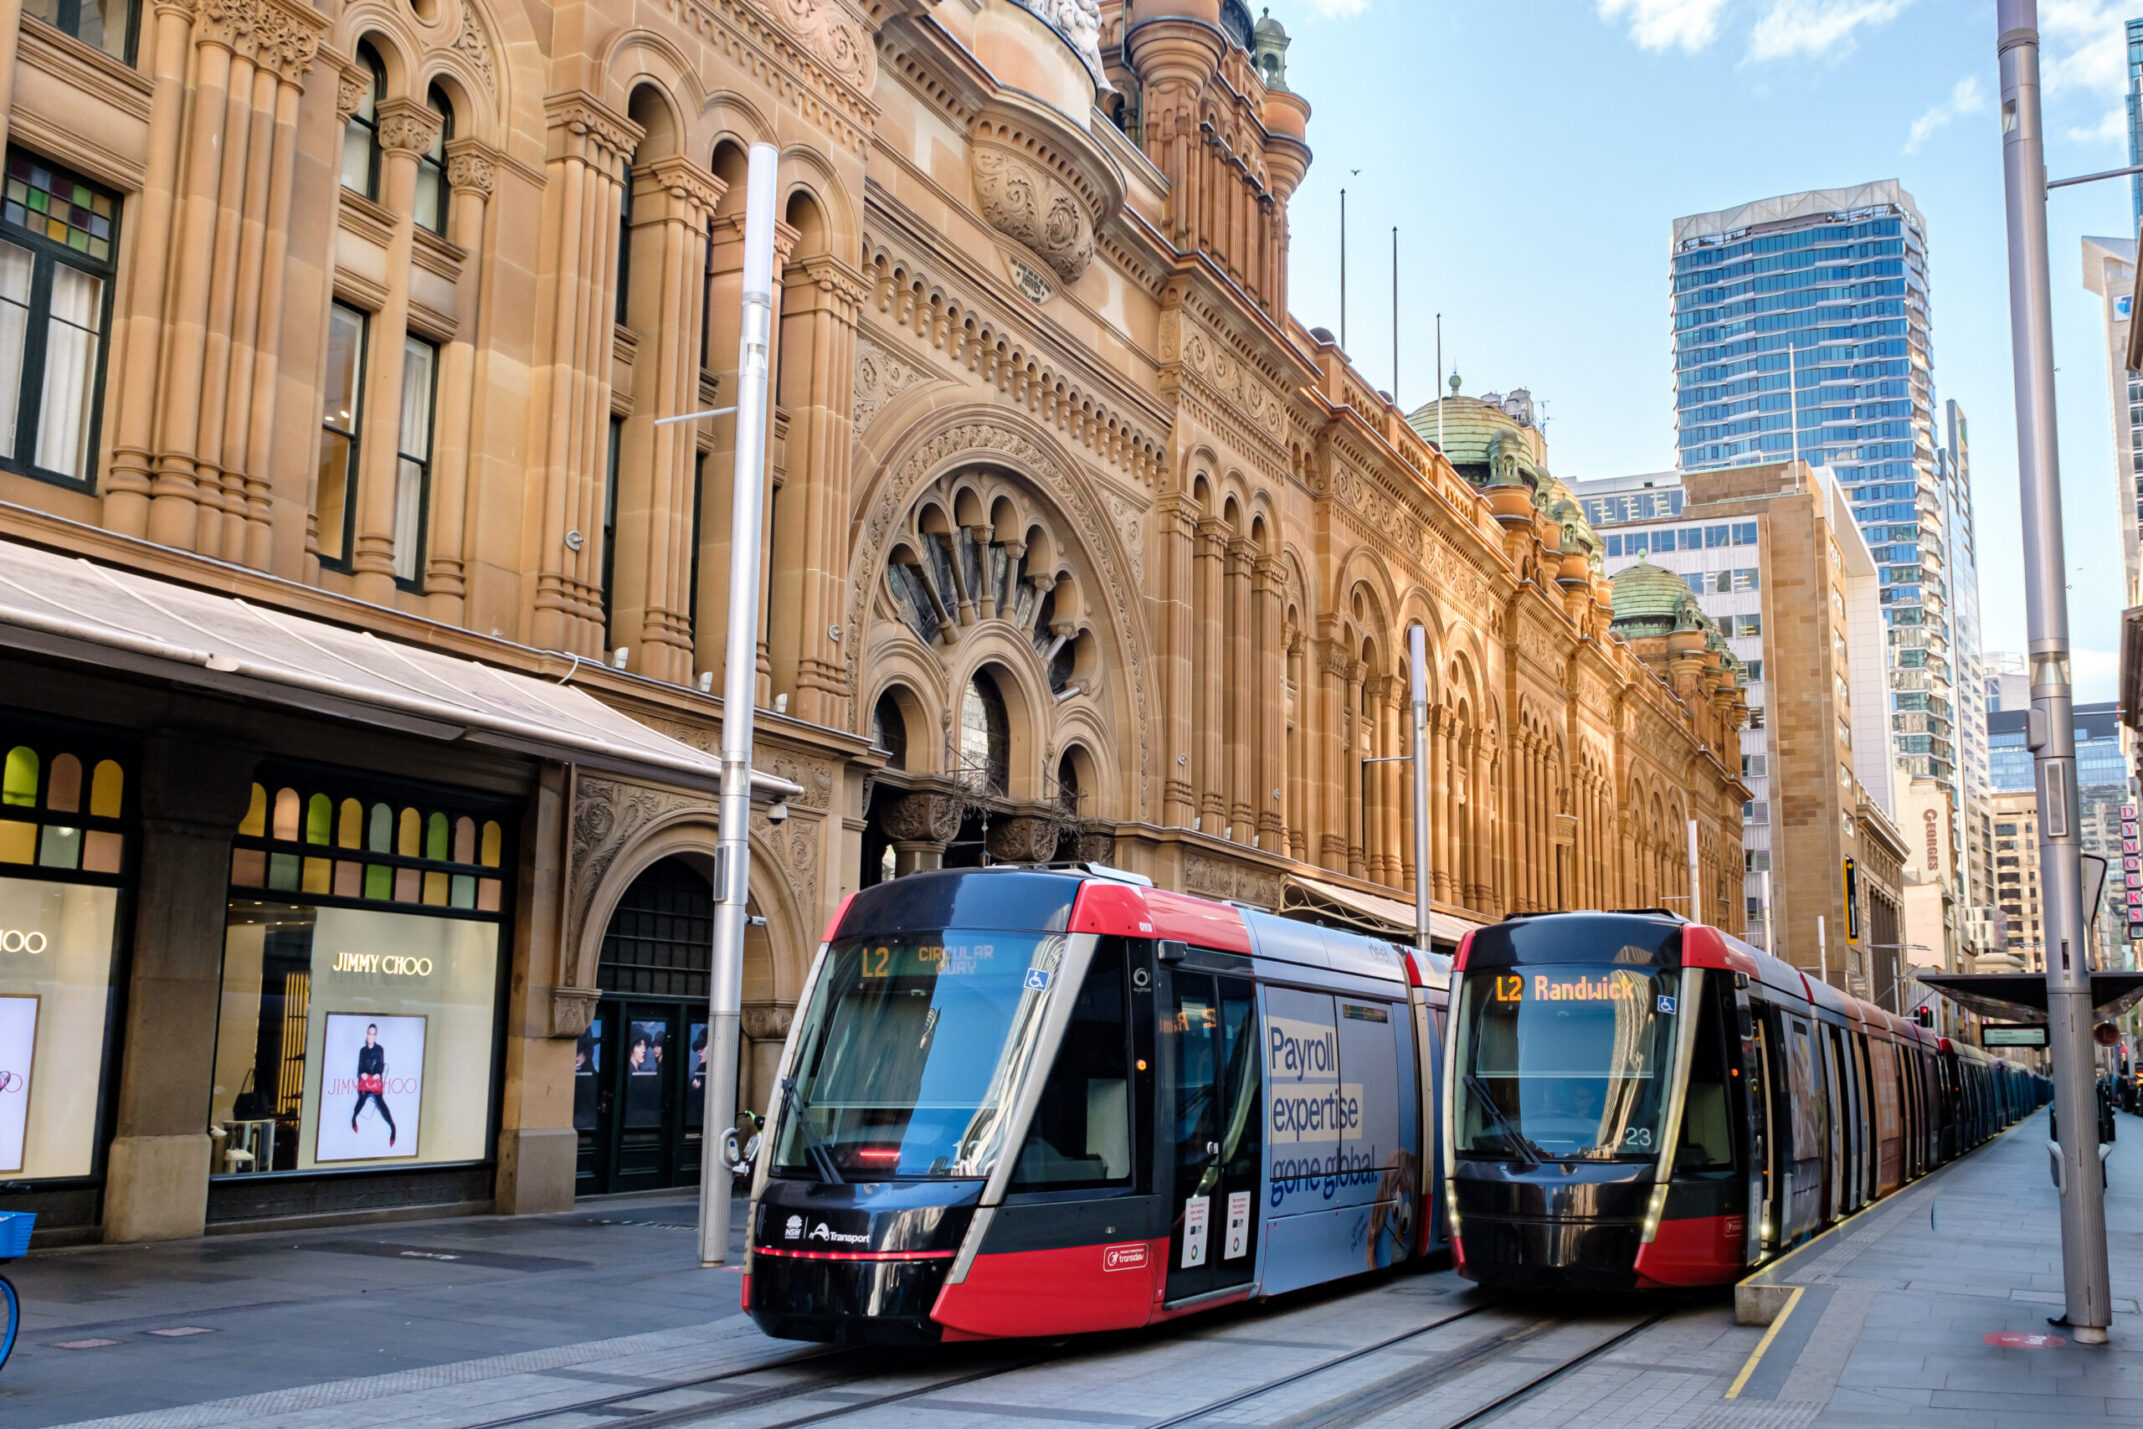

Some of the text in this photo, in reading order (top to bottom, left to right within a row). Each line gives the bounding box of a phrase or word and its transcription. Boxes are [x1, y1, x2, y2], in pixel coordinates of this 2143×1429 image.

[1922, 808, 1939, 871] GEORGES
[2122, 806, 2141, 921] DYMOCKS
[0, 929, 48, 954] OO
[332, 952, 432, 976] JIMMY CHOO
[862, 944, 994, 978] L2 CIRCULAR
[1496, 975, 1634, 1001] L2 Randwick
[1270, 1026, 1335, 1082] Payroll
[1273, 1088, 1359, 1142] expertise
[1625, 1127, 1651, 1146] 23
[1270, 1144, 1378, 1208] gone global.
[830, 1231, 871, 1244] Transport
